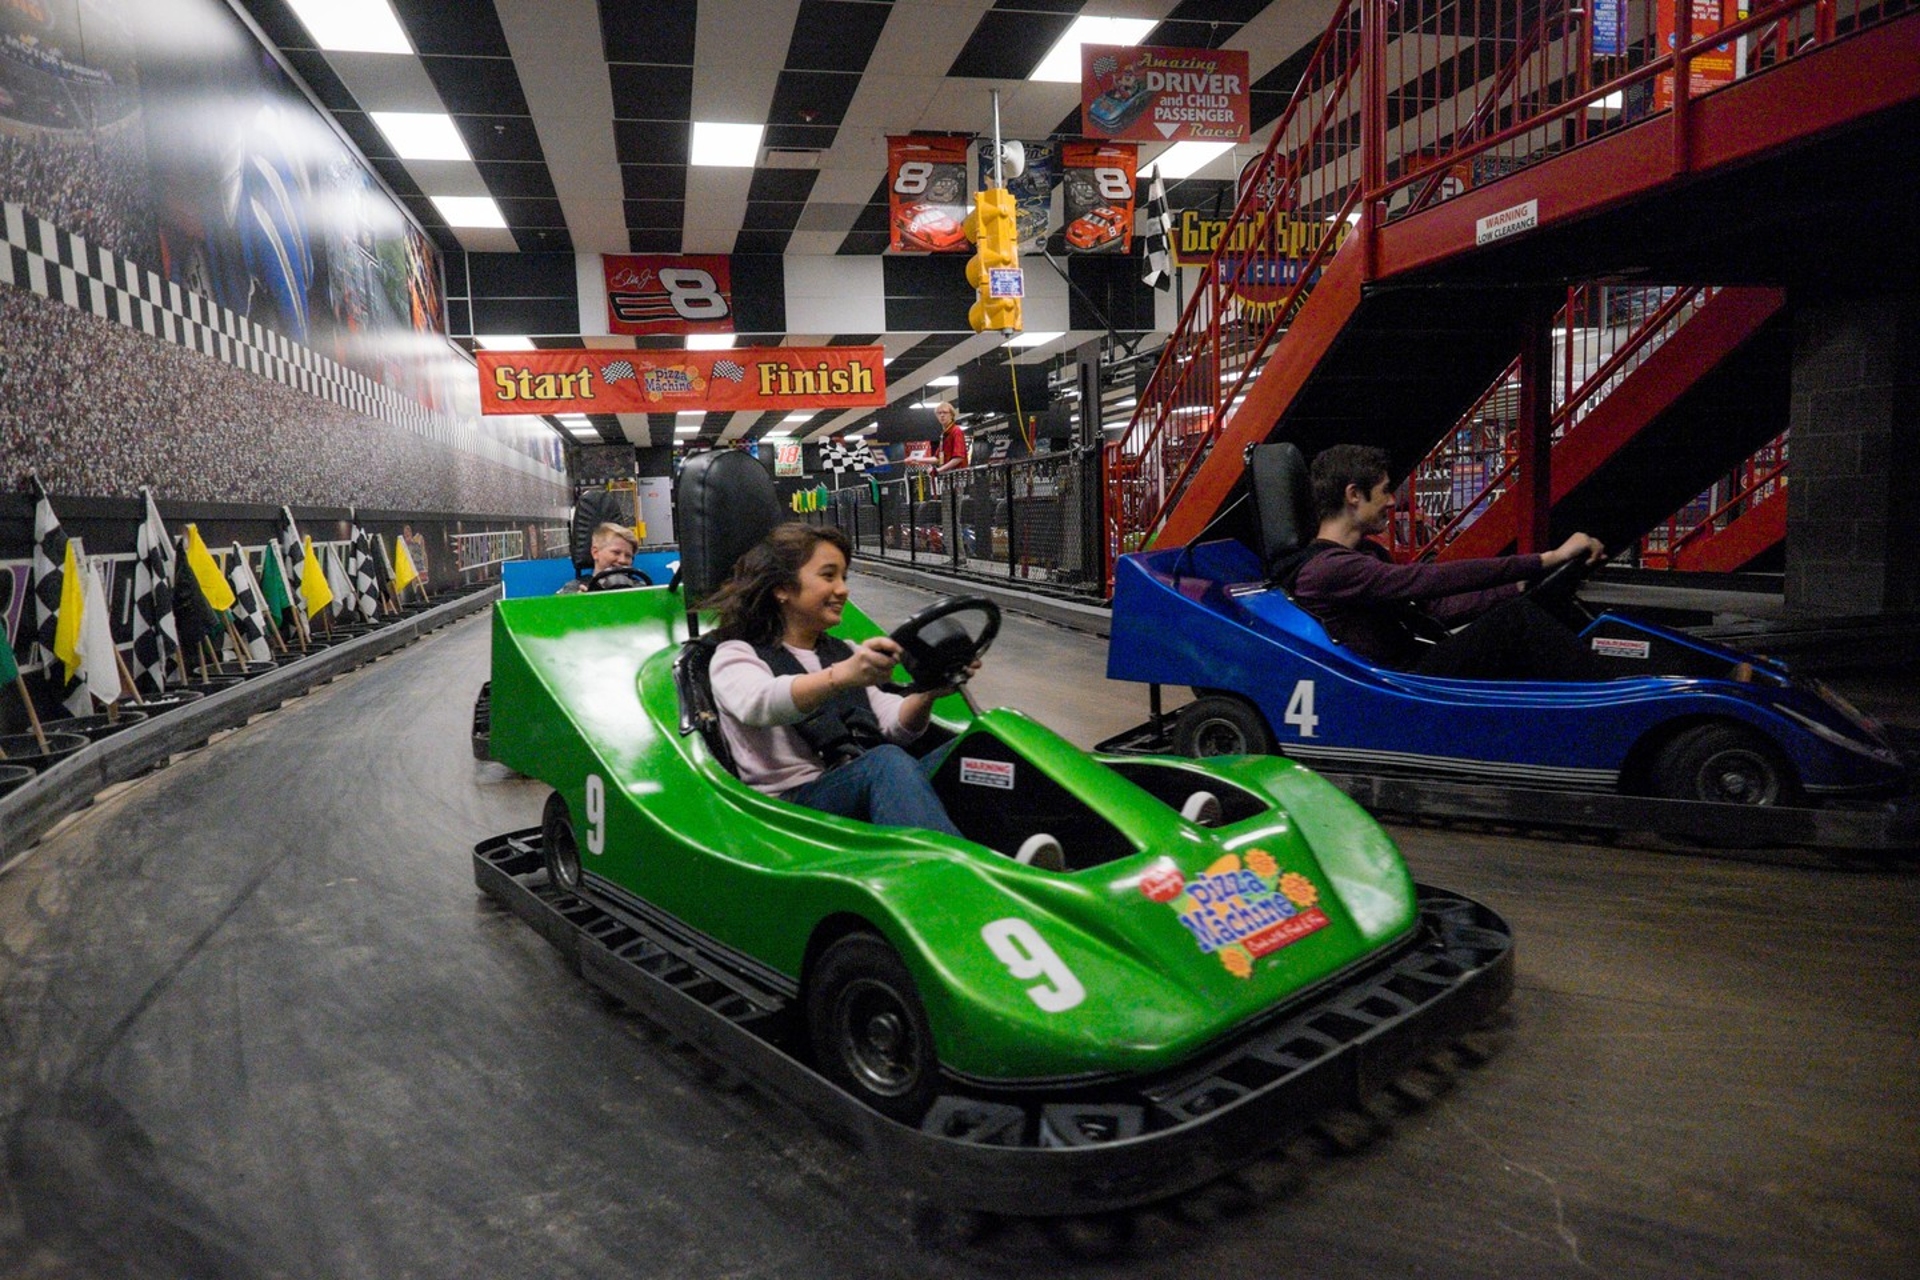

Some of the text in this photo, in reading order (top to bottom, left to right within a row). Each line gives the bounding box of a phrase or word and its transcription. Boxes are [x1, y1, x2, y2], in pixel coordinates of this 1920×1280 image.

[1137, 52, 1217, 74] Amazing
[1146, 71, 1241, 95] DRIVER
[1154, 107, 1235, 122] PASSENGER
[1160, 94, 1229, 108] and CHILD
[1189, 123, 1244, 138] Race!
[894, 162, 934, 194] 8
[1094, 167, 1132, 200] 8
[1477, 216, 1536, 244] LOW CLEARANCE
[1485, 205, 1528, 230] WARNING
[1218, 263, 1316, 279] RCIN
[658, 268, 729, 318] 8
[494, 365, 595, 400] Start
[645, 378, 693, 392] Machine
[655, 368, 688, 382] Pizza
[757, 361, 875, 396] Finish
[777, 445, 800, 464] 18
[1284, 680, 1319, 737] 4
[586, 774, 605, 855] 9
[1184, 869, 1269, 918] Pizza
[1178, 892, 1298, 953] Machine
[981, 917, 1086, 1012] 9
